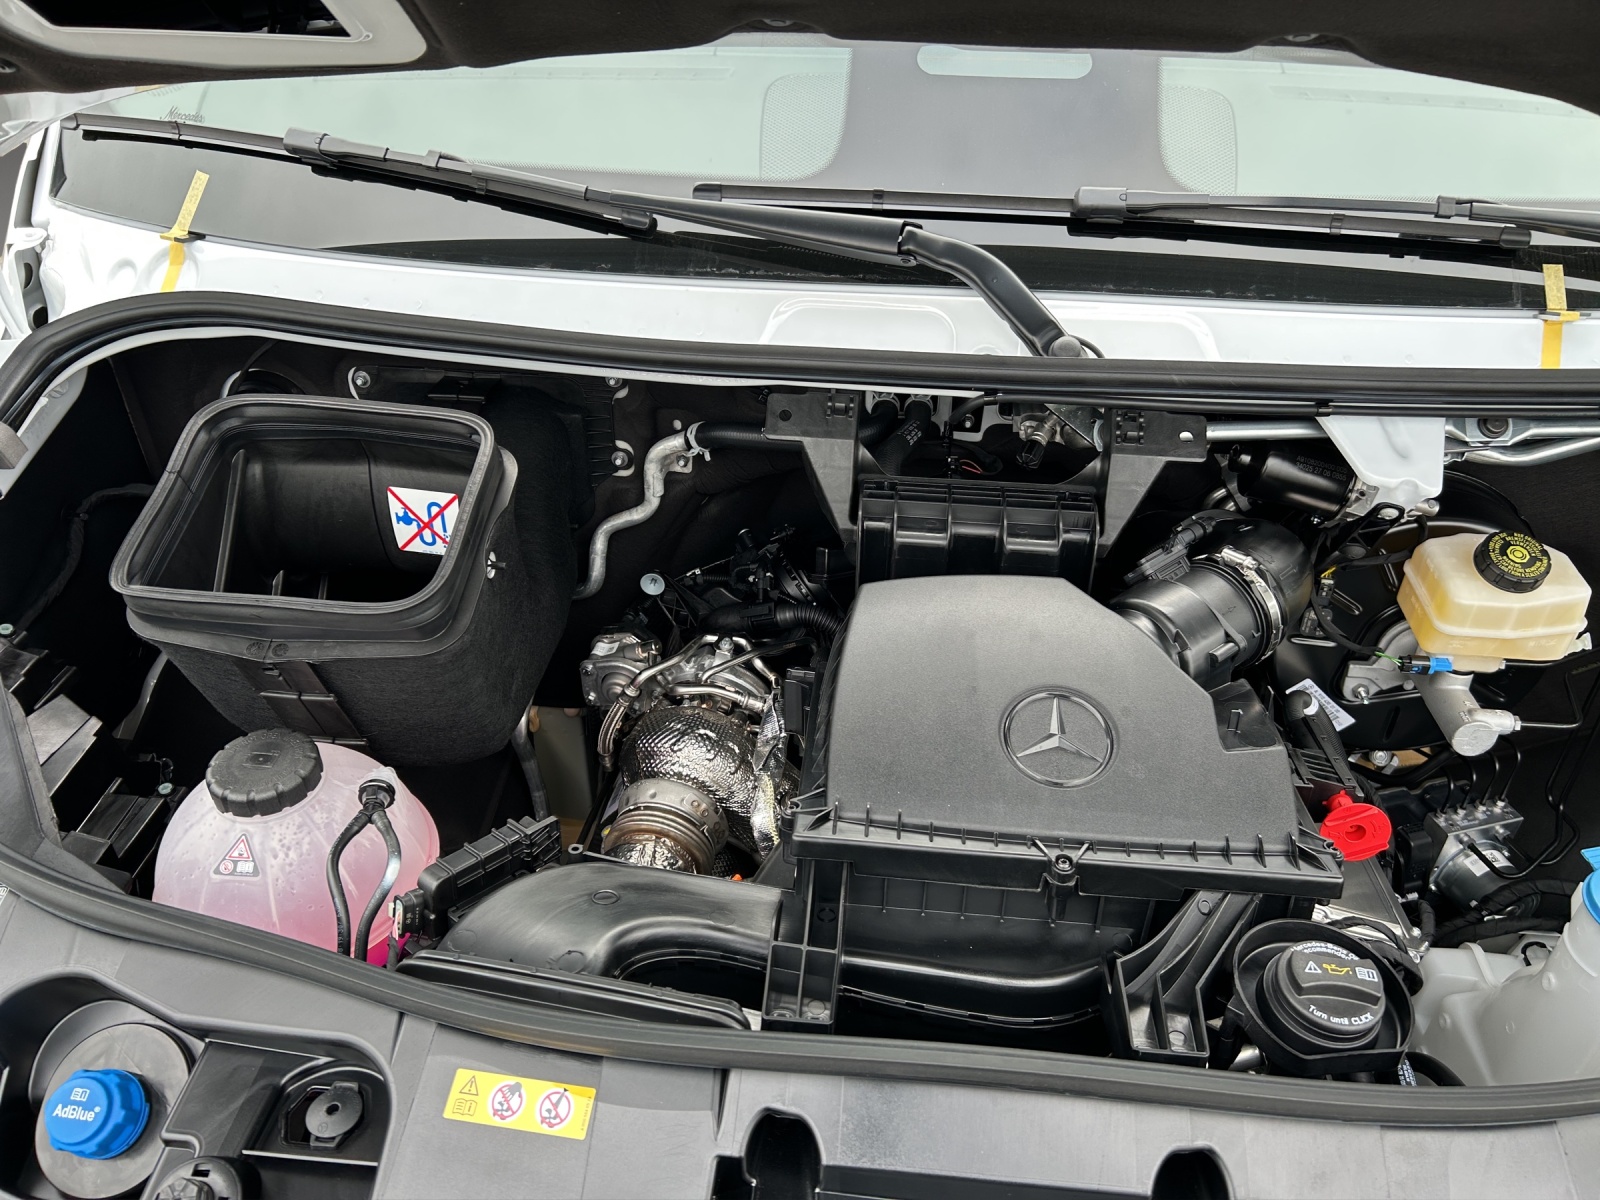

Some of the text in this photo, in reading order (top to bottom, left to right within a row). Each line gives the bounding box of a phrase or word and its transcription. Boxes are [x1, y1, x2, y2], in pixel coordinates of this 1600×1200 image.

[1308, 1004, 1374, 1025] Turn until CLICK
